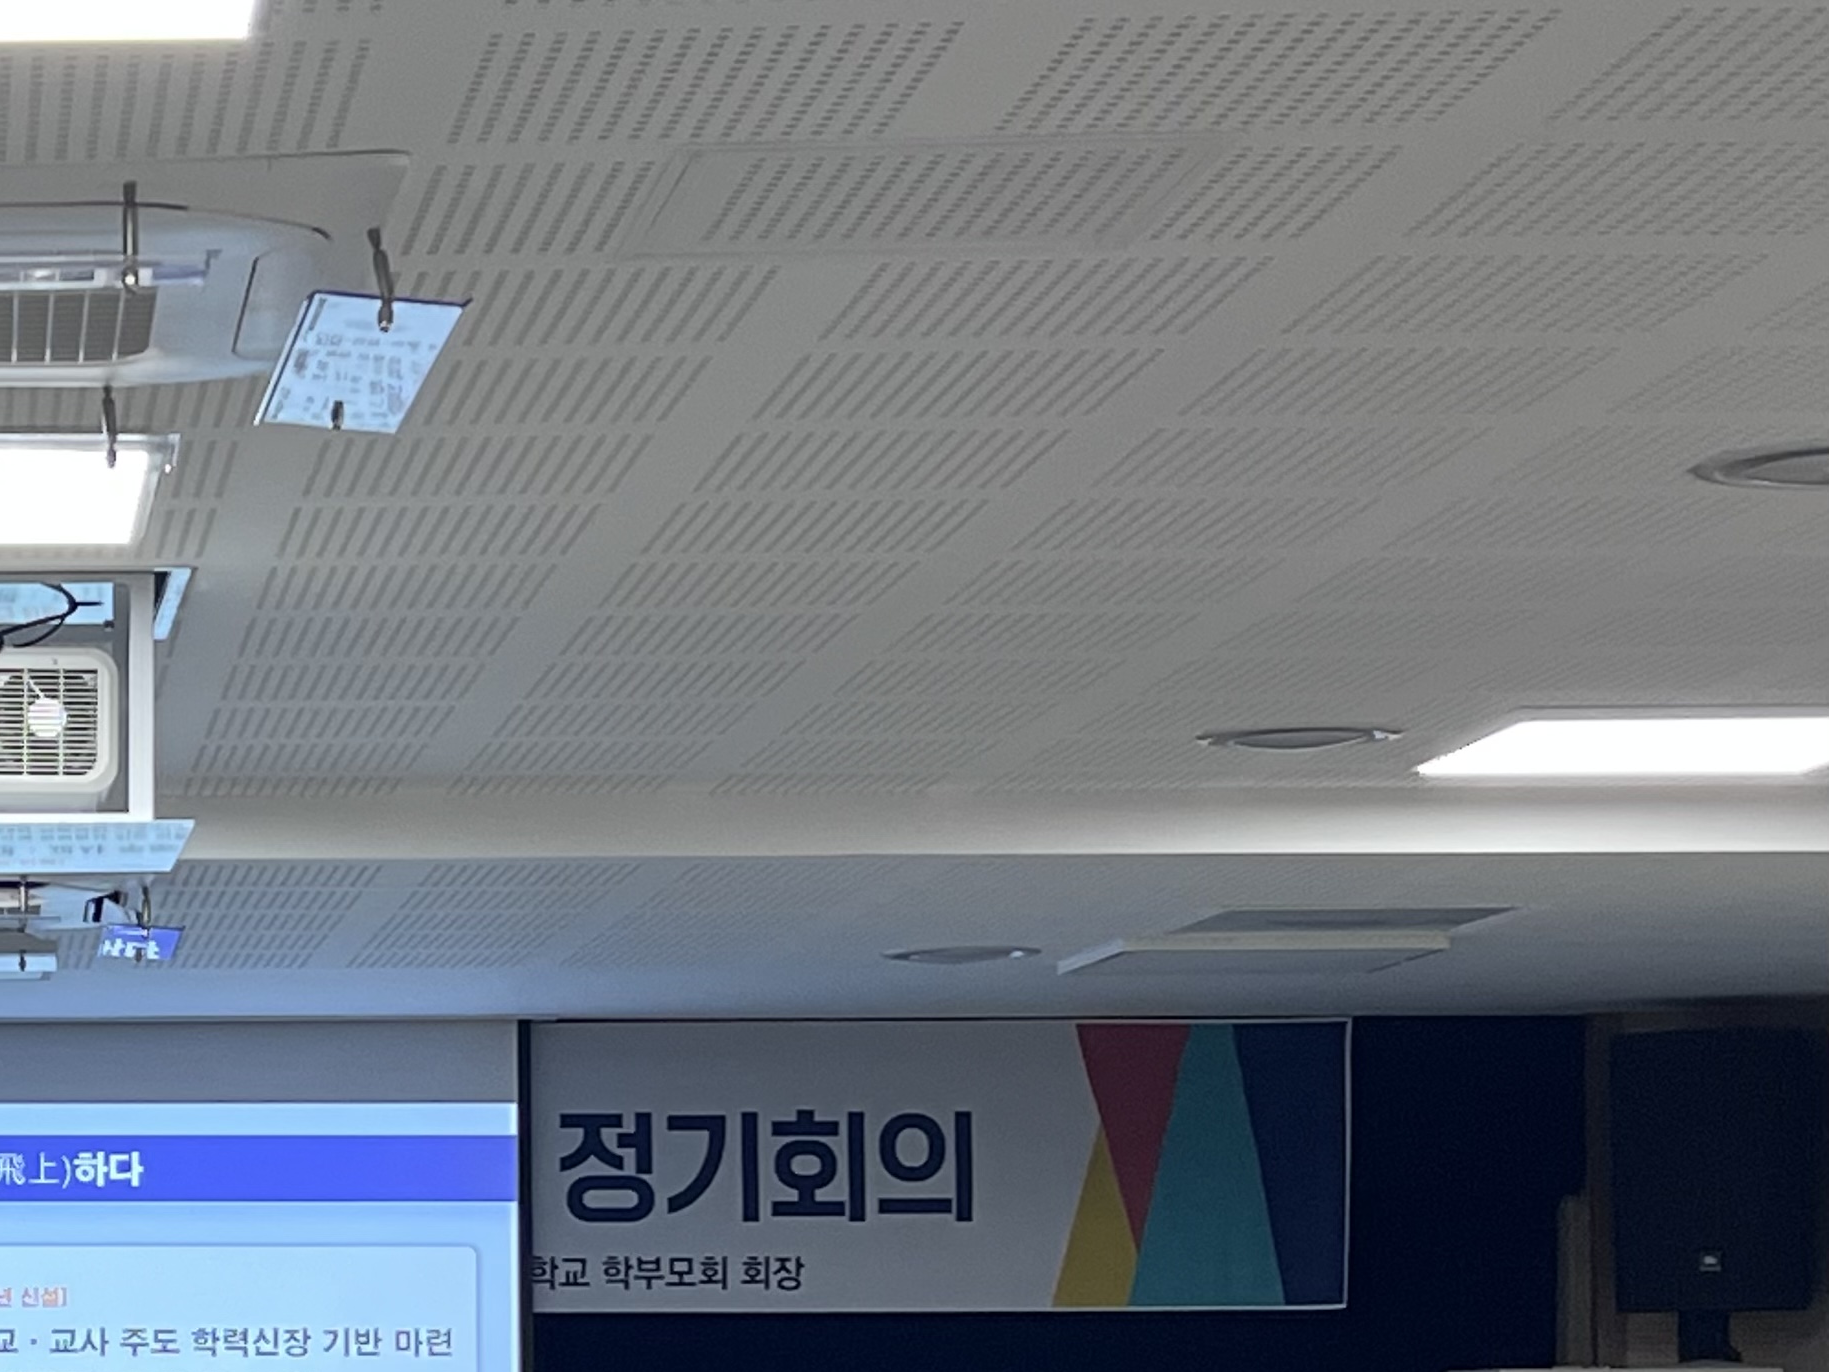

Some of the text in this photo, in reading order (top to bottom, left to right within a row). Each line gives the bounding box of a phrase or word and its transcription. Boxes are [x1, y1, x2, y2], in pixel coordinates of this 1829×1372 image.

[558, 1109, 973, 1223] 정기회의
[602, 1256, 728, 1291] 학부모회
[740, 1256, 805, 1291] 회장
[21, 1287, 68, 1308] 신설]
[49, 1326, 109, 1358] 교사
[119, 1326, 181, 1358] 주도
[190, 1326, 311, 1358] 학력신장
[322, 1326, 382, 1358] 기반
[394, 1326, 453, 1358] 마련
